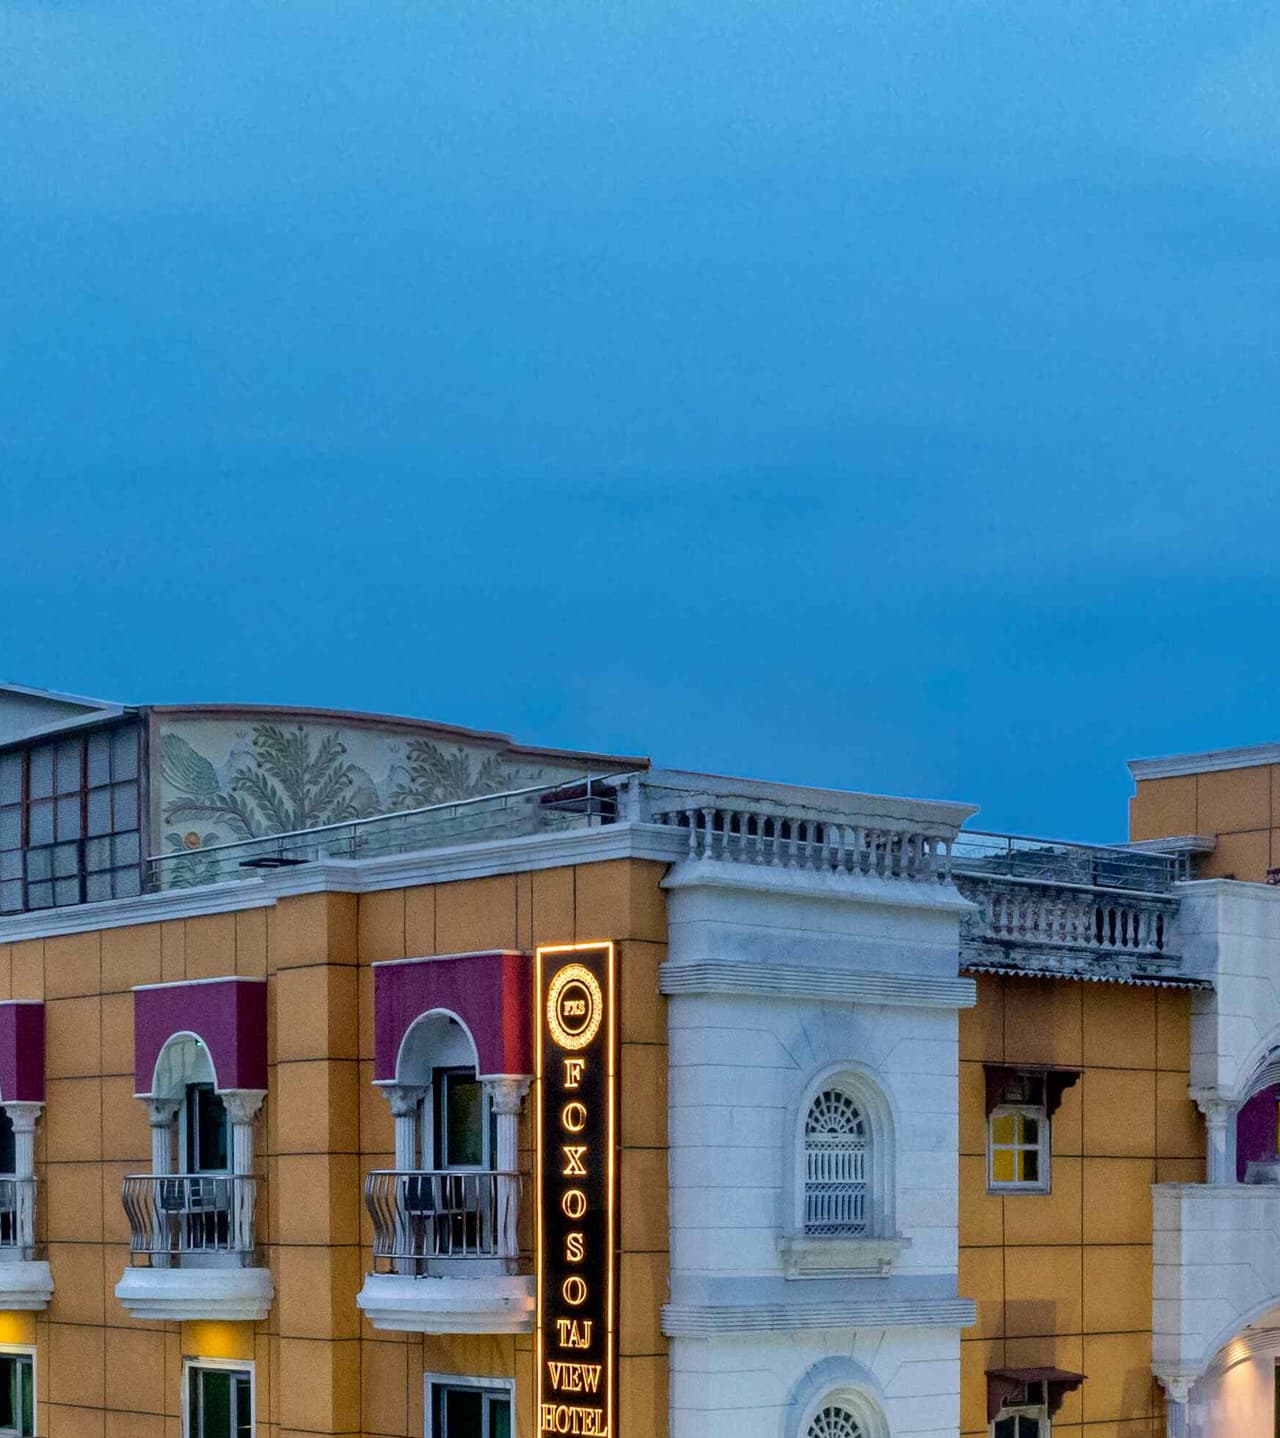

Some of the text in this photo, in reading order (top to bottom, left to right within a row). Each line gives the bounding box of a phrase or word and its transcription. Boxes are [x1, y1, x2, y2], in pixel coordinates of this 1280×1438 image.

[561, 1058, 588, 1306] FOXOSO
[556, 1319, 593, 1349] TAJ
[547, 1361, 602, 1393] VIEW
[541, 1403, 608, 1438] HOTEL
